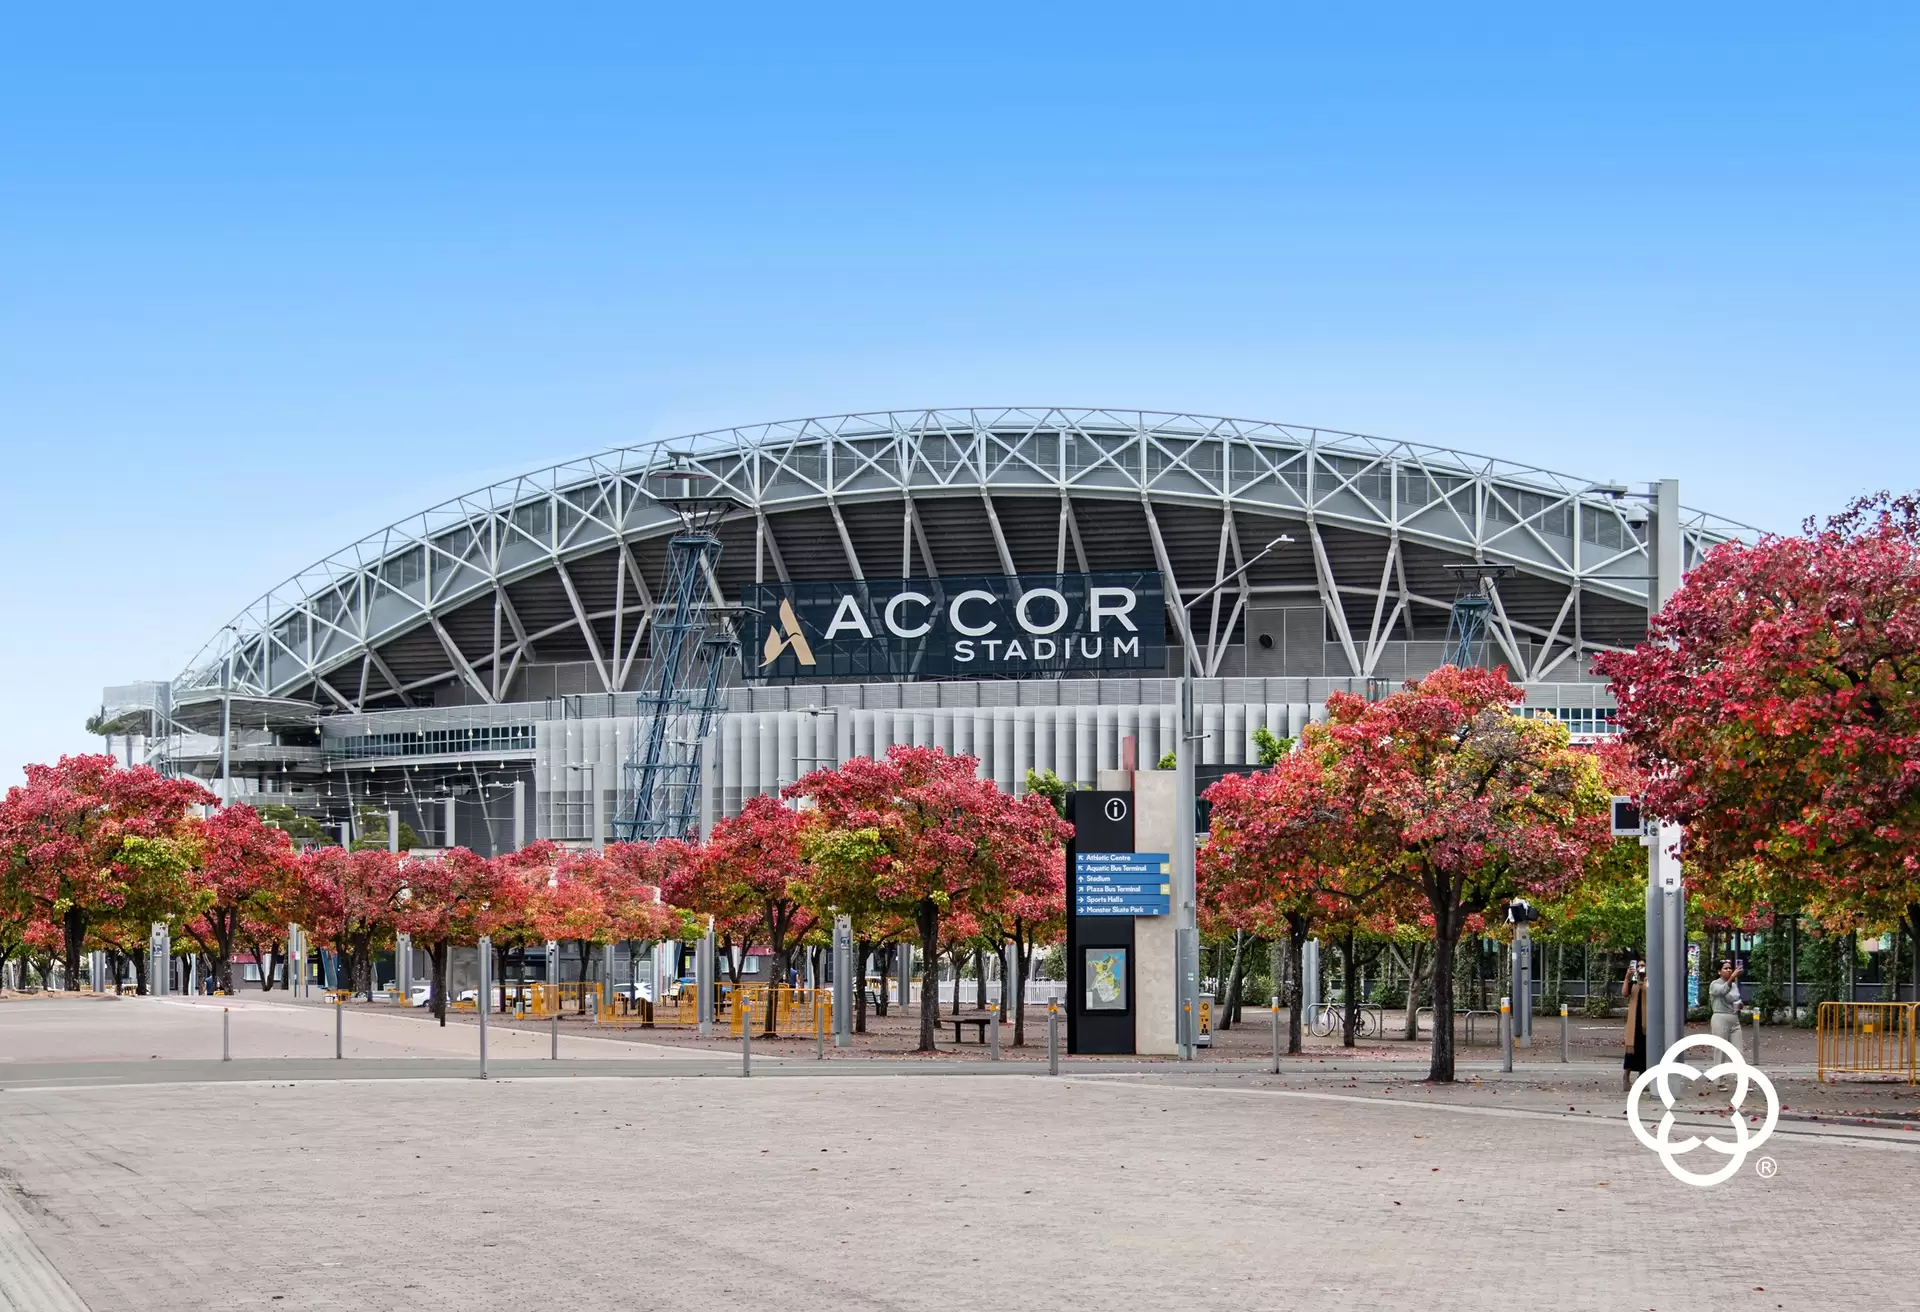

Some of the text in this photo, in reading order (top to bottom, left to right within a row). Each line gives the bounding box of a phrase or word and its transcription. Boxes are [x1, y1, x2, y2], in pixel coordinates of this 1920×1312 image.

[823, 587, 1139, 640] ACCOR
[953, 636, 1139, 662] STADIUM
[1086, 896, 1106, 904] Sports
